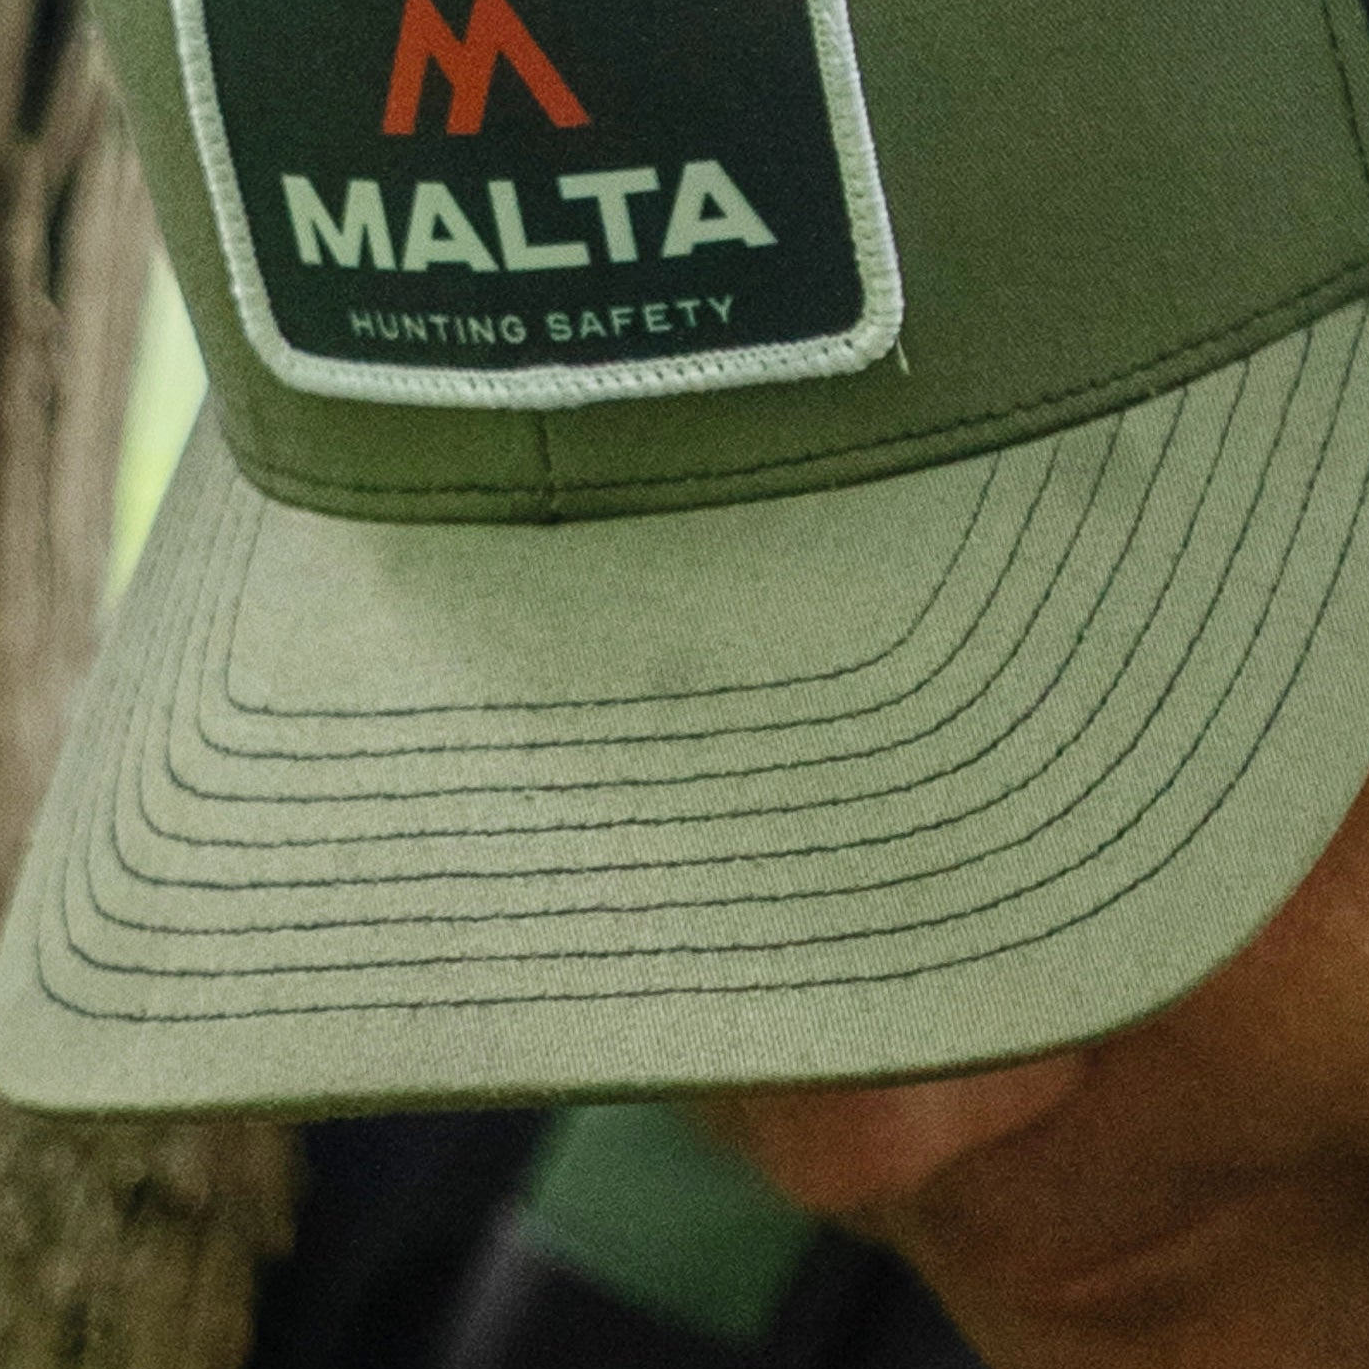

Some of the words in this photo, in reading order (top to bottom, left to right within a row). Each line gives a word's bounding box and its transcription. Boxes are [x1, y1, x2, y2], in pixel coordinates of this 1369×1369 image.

[281, 159, 778, 273] MALTA
[350, 310, 527, 345] HUNTING
[547, 295, 734, 339] SAFETY
